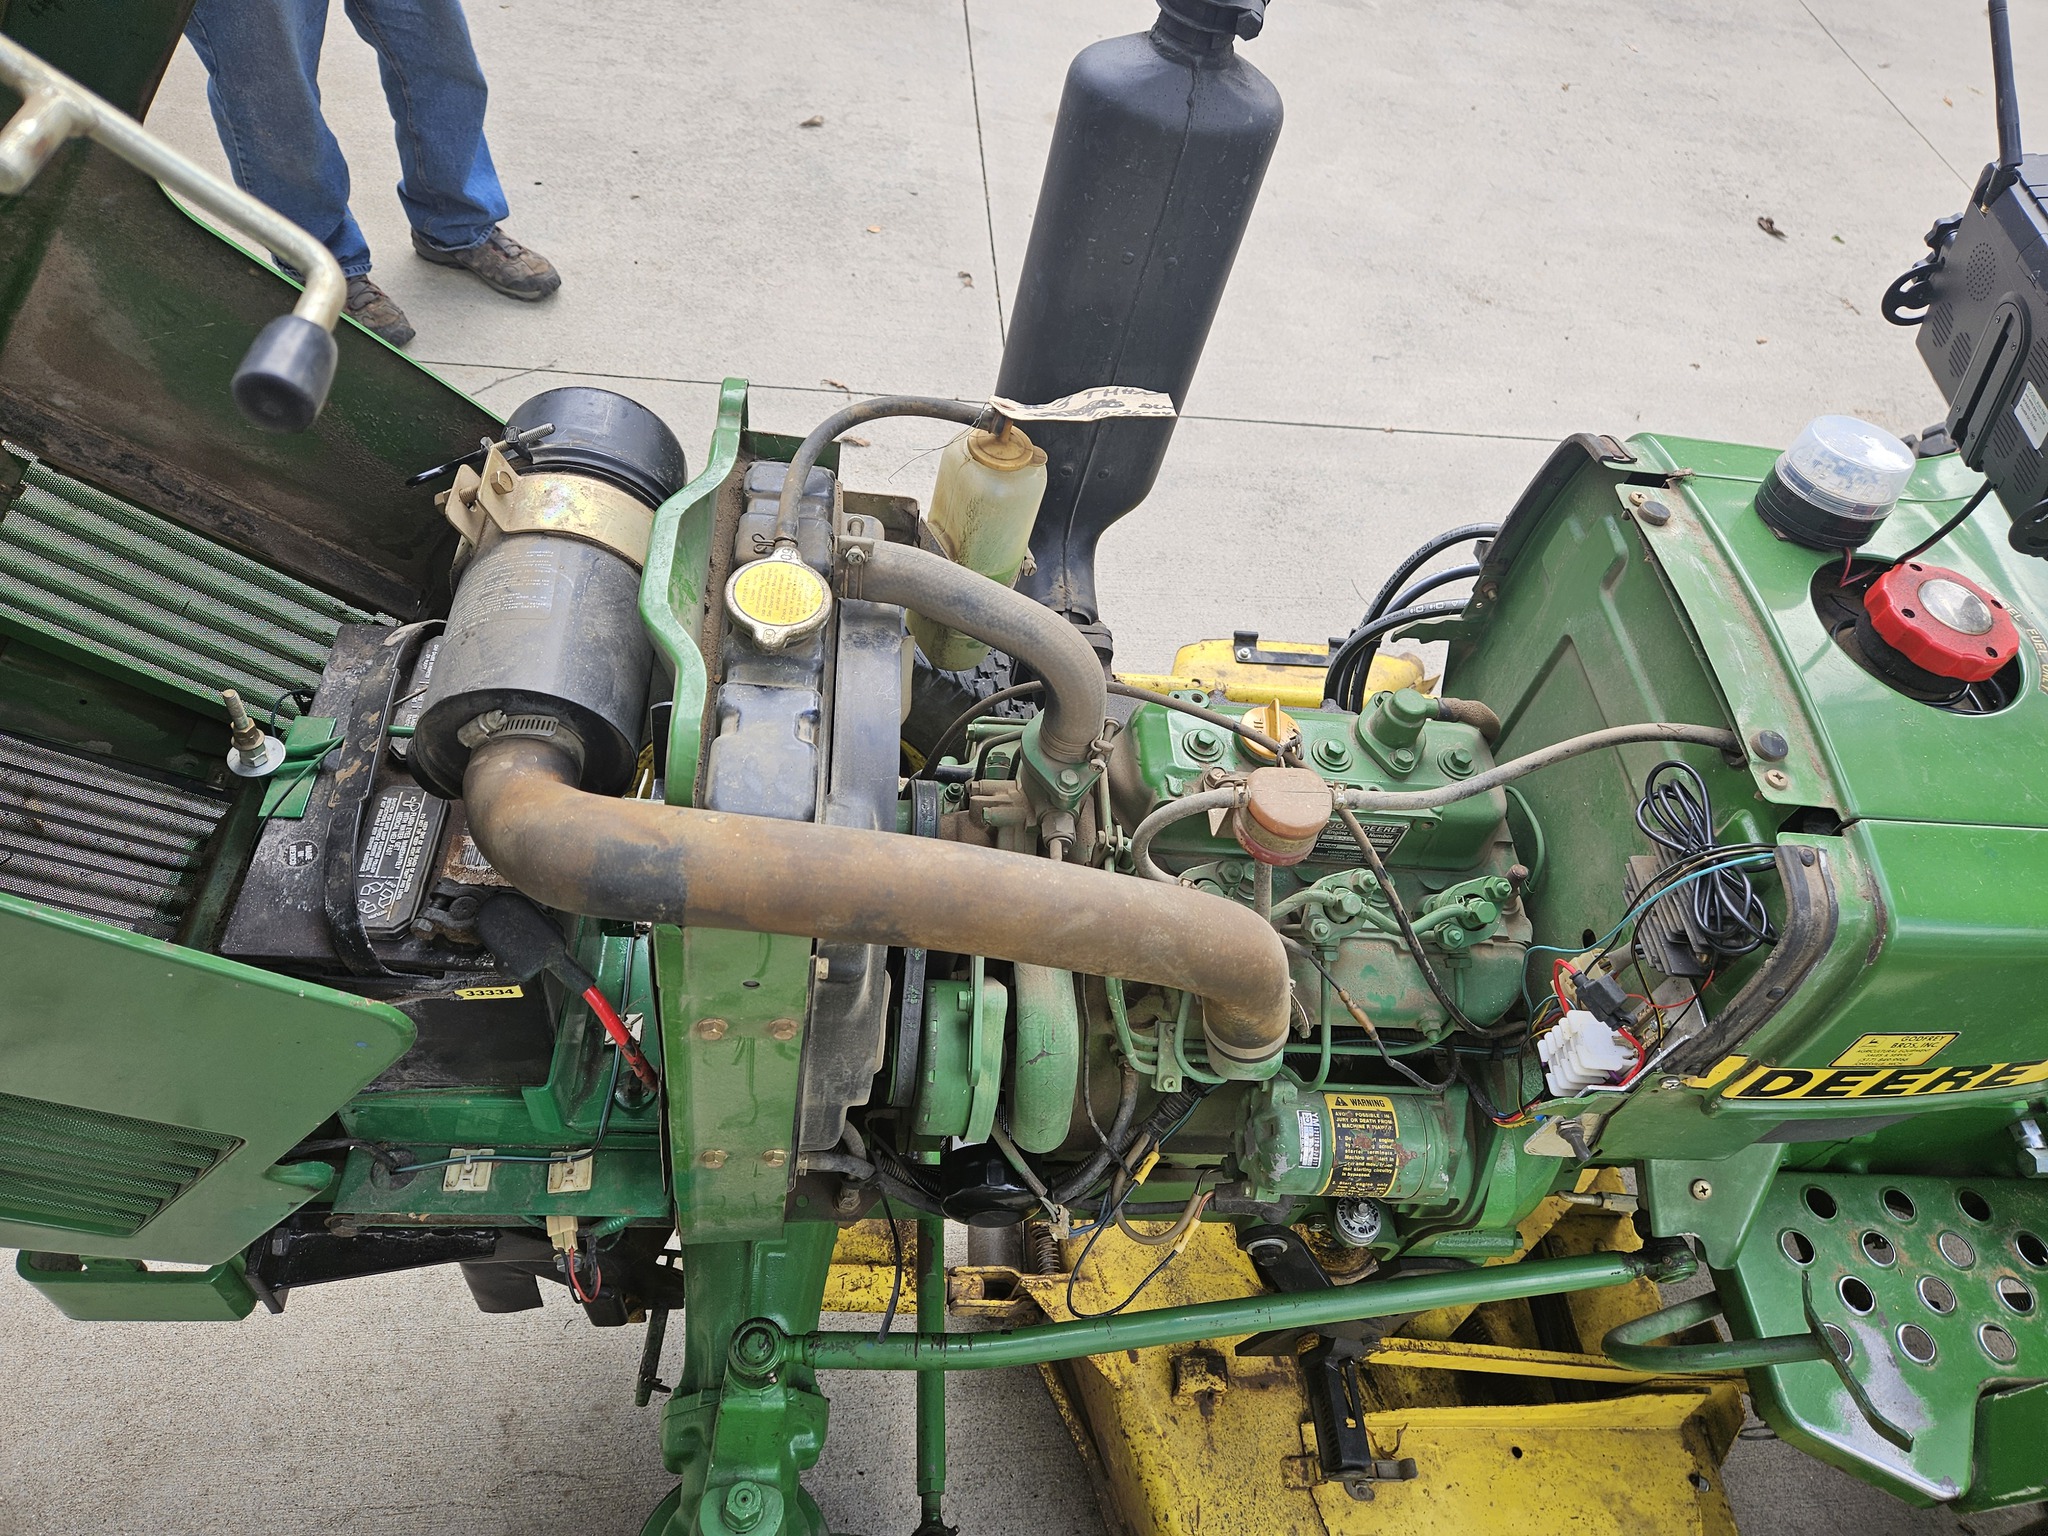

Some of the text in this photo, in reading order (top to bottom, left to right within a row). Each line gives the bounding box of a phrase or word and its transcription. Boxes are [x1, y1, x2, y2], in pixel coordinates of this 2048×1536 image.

[1416, 541, 1433, 556] PSI)
[2026, 628, 2047, 656] FUEL
[401, 811, 410, 824] WITH
[385, 811, 404, 857] MEDICAL HELP FAST
[1362, 825, 1400, 833] DEERE
[393, 841, 401, 852] GET
[394, 811, 417, 870] FLUSH EYES IMMEDIATELY
[289, 845, 297, 865] MEXICO
[305, 845, 313, 861] MADE
[1736, 1060, 2041, 1097] DEERE
[1350, 1098, 1386, 1108] WARNING
[1312, 1113, 1320, 1126] YM
